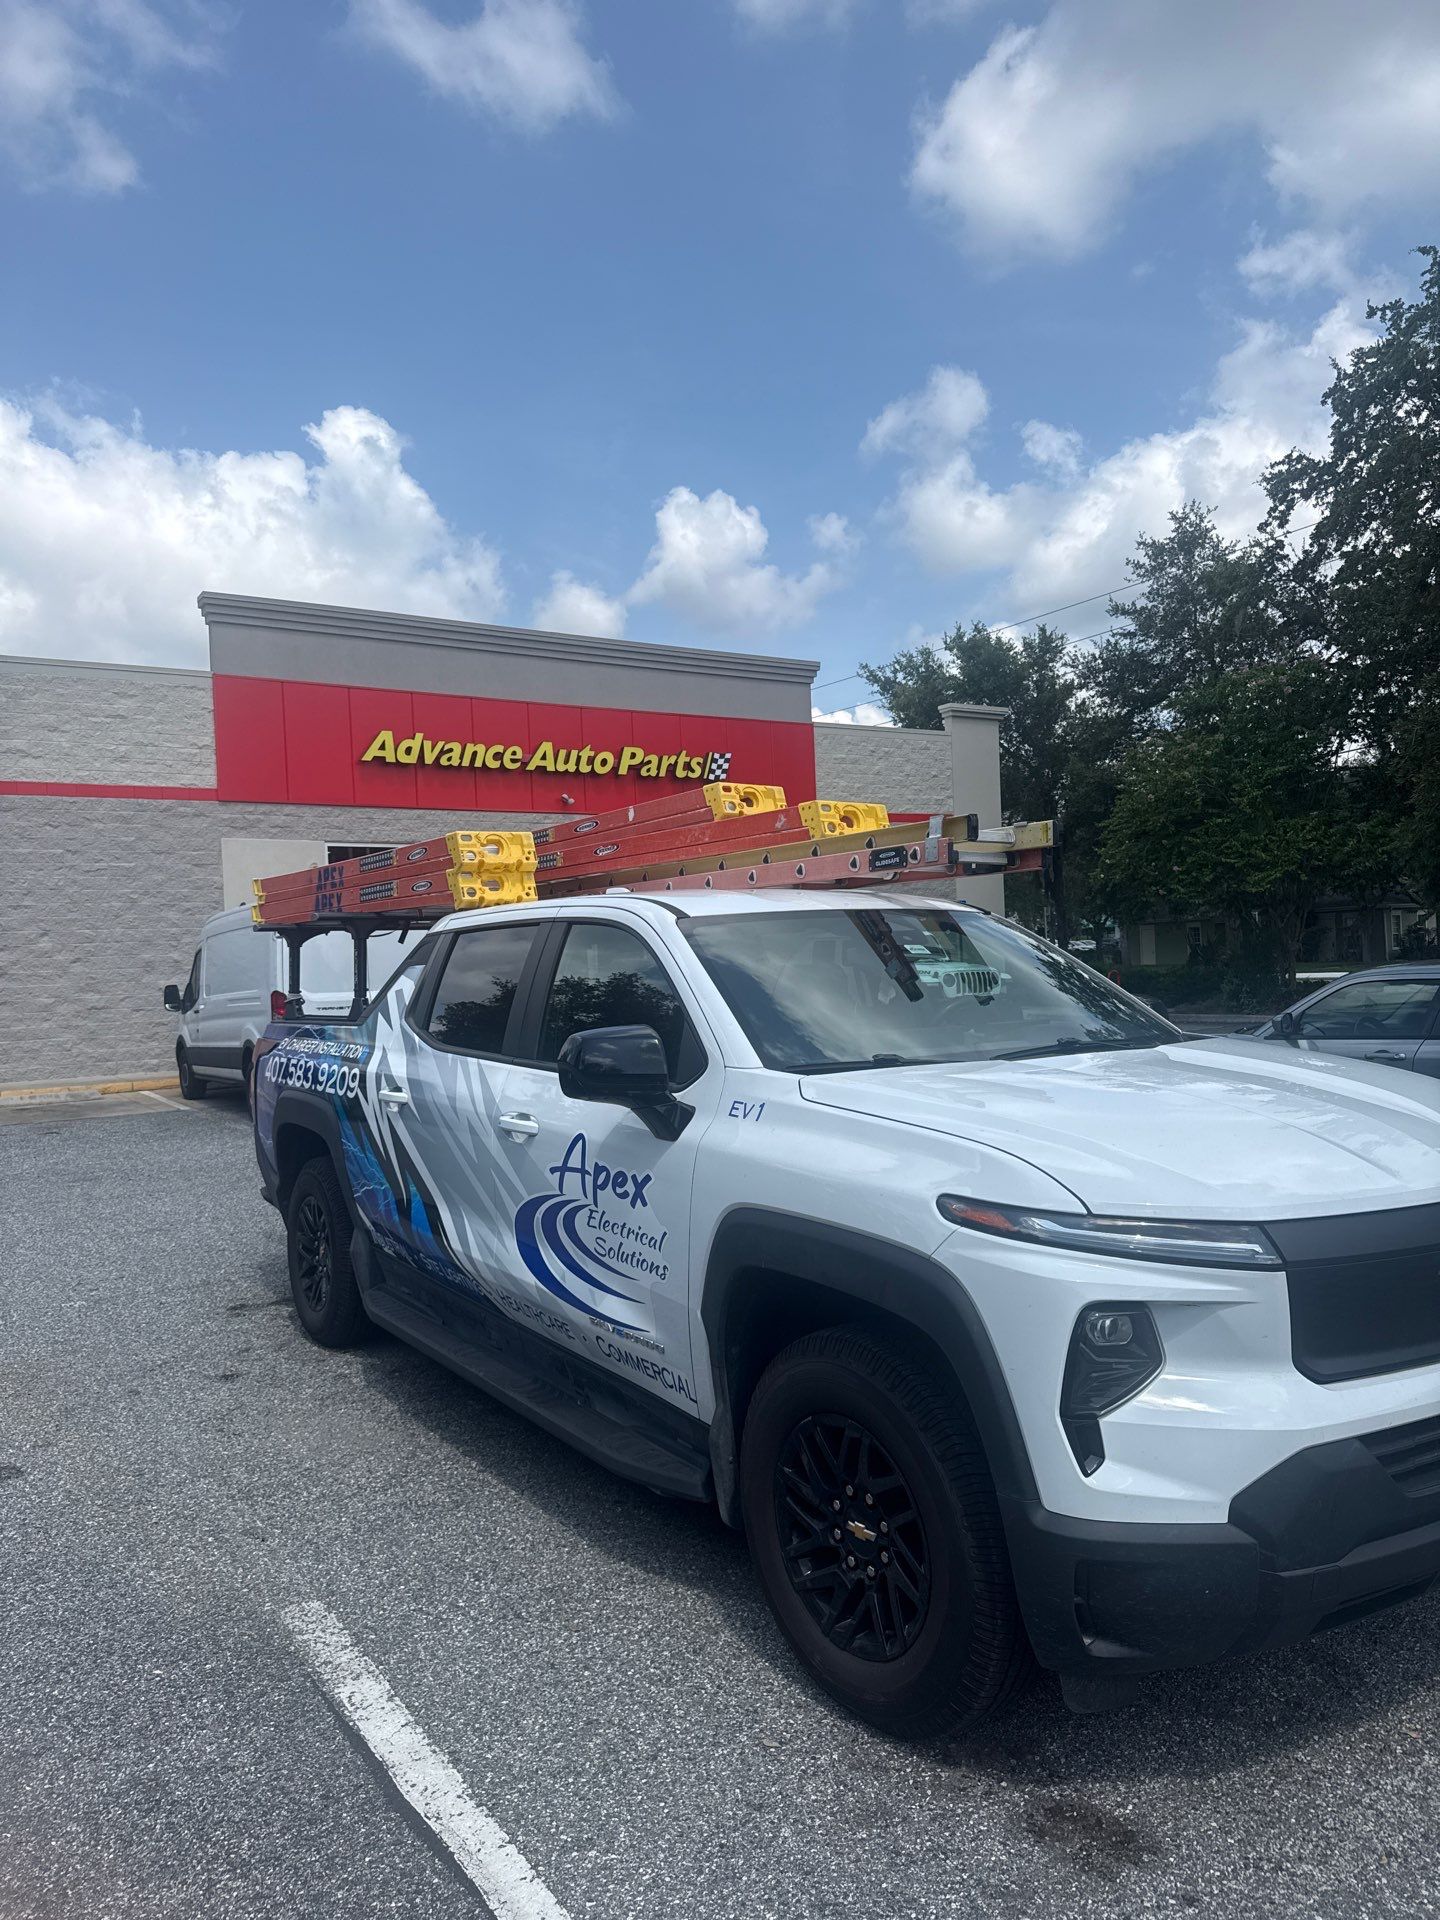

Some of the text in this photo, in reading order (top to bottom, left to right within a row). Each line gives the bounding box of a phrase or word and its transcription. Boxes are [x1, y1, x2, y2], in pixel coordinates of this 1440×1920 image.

[361, 730, 703, 779] Advance Auto Parts
[313, 1042, 363, 1059] INSTALLATION
[265, 1057, 360, 1098] 407.583.9209
[728, 1100, 766, 1122] EV1
[549, 1132, 653, 1209] Apex
[586, 1208, 668, 1254] Electrical
[593, 1237, 669, 1281] Solutions
[495, 1290, 576, 1341] HEALTHCARE
[595, 1336, 698, 1404] COMMERCIAL
